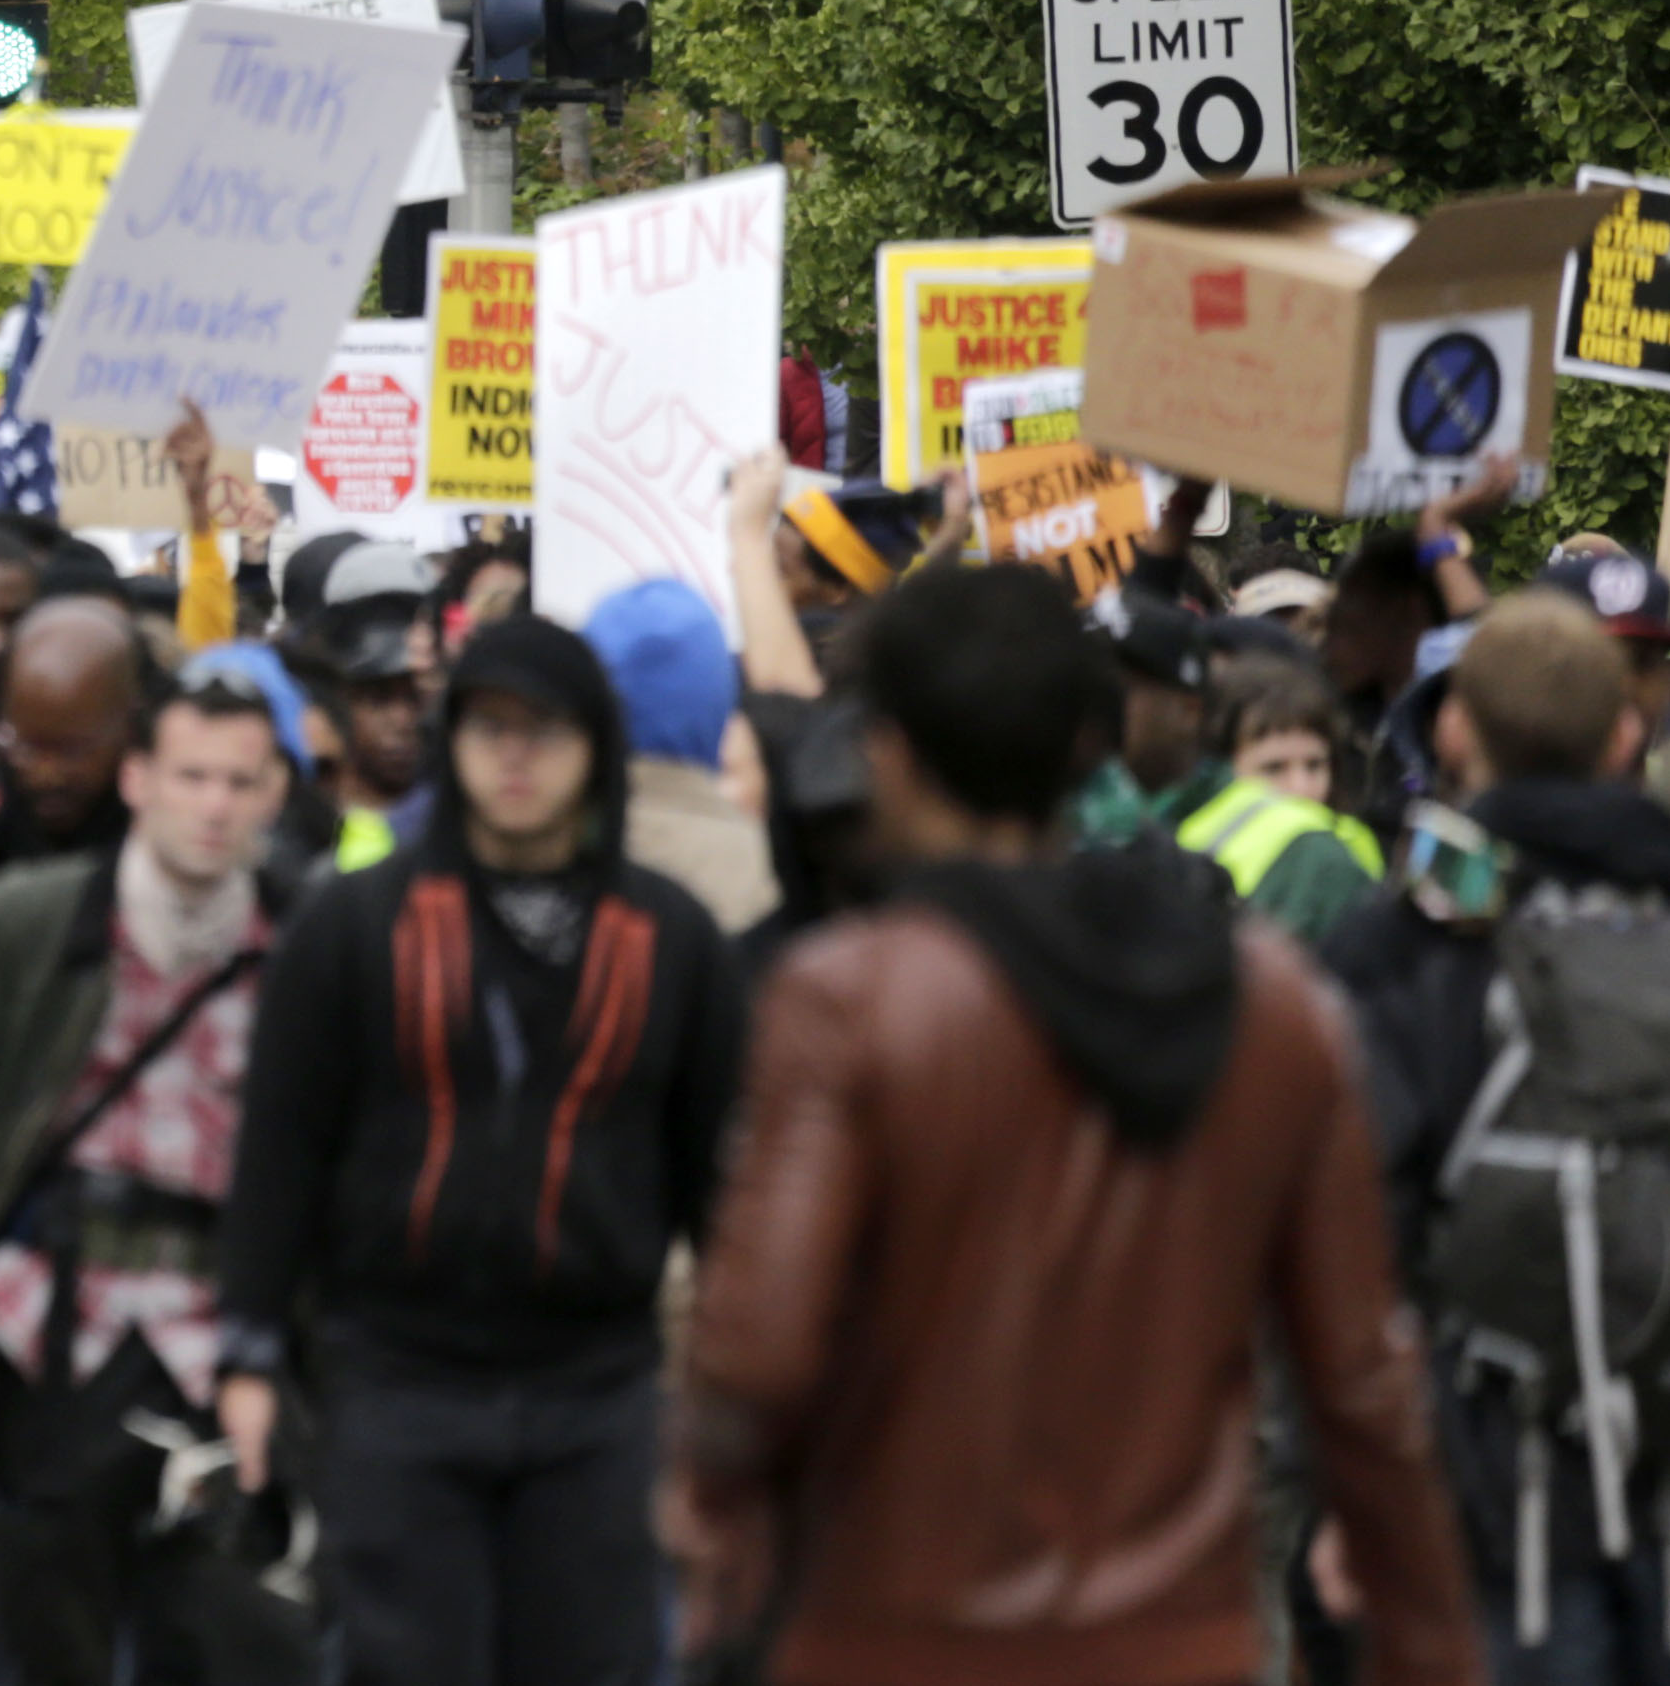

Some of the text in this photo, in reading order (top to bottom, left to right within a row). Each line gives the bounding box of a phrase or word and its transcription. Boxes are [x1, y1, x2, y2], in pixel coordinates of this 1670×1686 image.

[1093, 16, 1245, 64] LIMIT
[1085, 75, 1265, 185] 30
[549, 195, 780, 308] THINK
[440, 259, 535, 295] JUST
[918, 294, 1066, 330] JUSTICE
[1580, 299, 1670, 346] DEFIAN
[956, 335, 1059, 369] MIKE
[1013, 498, 1099, 561] NOT
